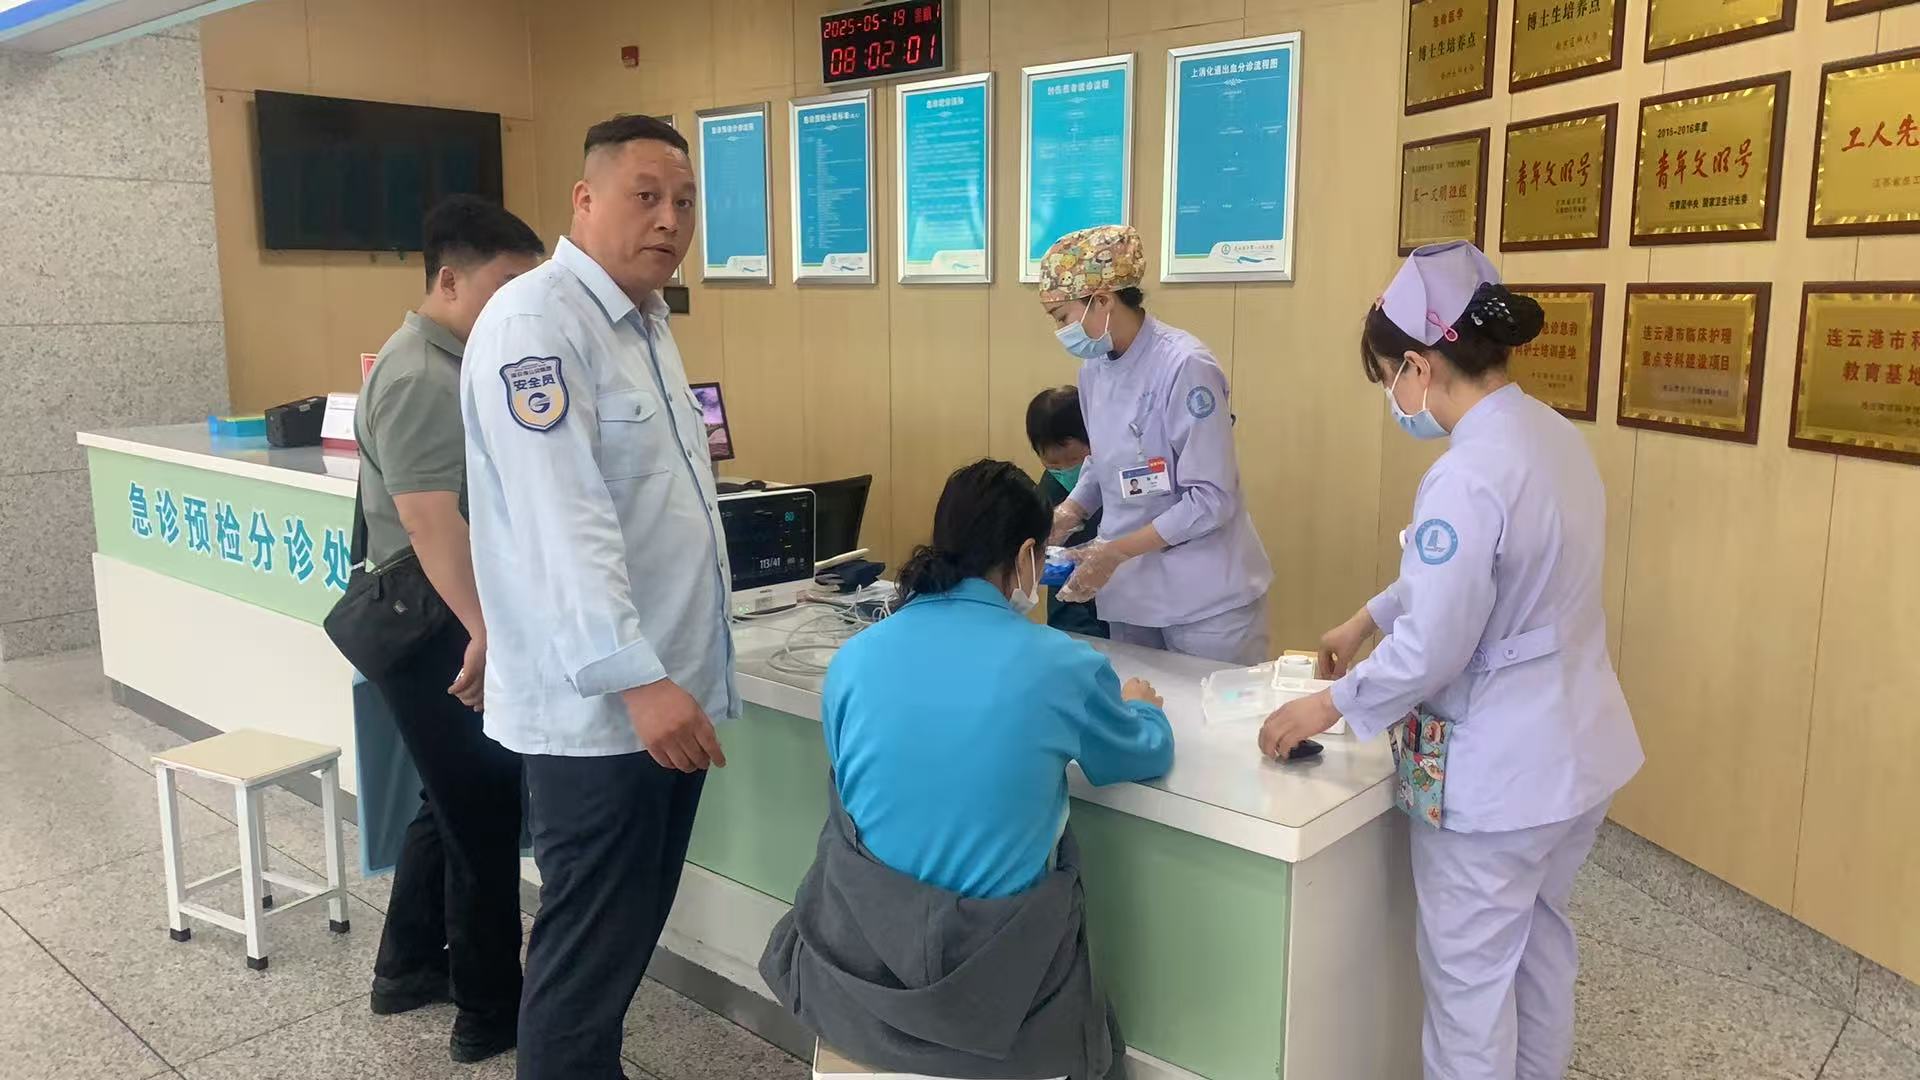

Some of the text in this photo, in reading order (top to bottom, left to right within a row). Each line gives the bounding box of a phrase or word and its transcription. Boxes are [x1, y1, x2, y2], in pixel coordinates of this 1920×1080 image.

[824, 9, 905, 39] 2025-05-19
[830, 34, 937, 76] 08:02:01
[1418, 32, 1477, 62] 博士生培养点
[1517, 152, 1591, 197] 青年文明号
[1655, 139, 1753, 189] 青年文明号
[1641, 325, 1733, 344] 连云港市临床护理
[1641, 351, 1730, 371] 重点专科建设项目
[513, 374, 556, 391] 安全员
[128, 481, 351, 594] 急诊预检分诊处
